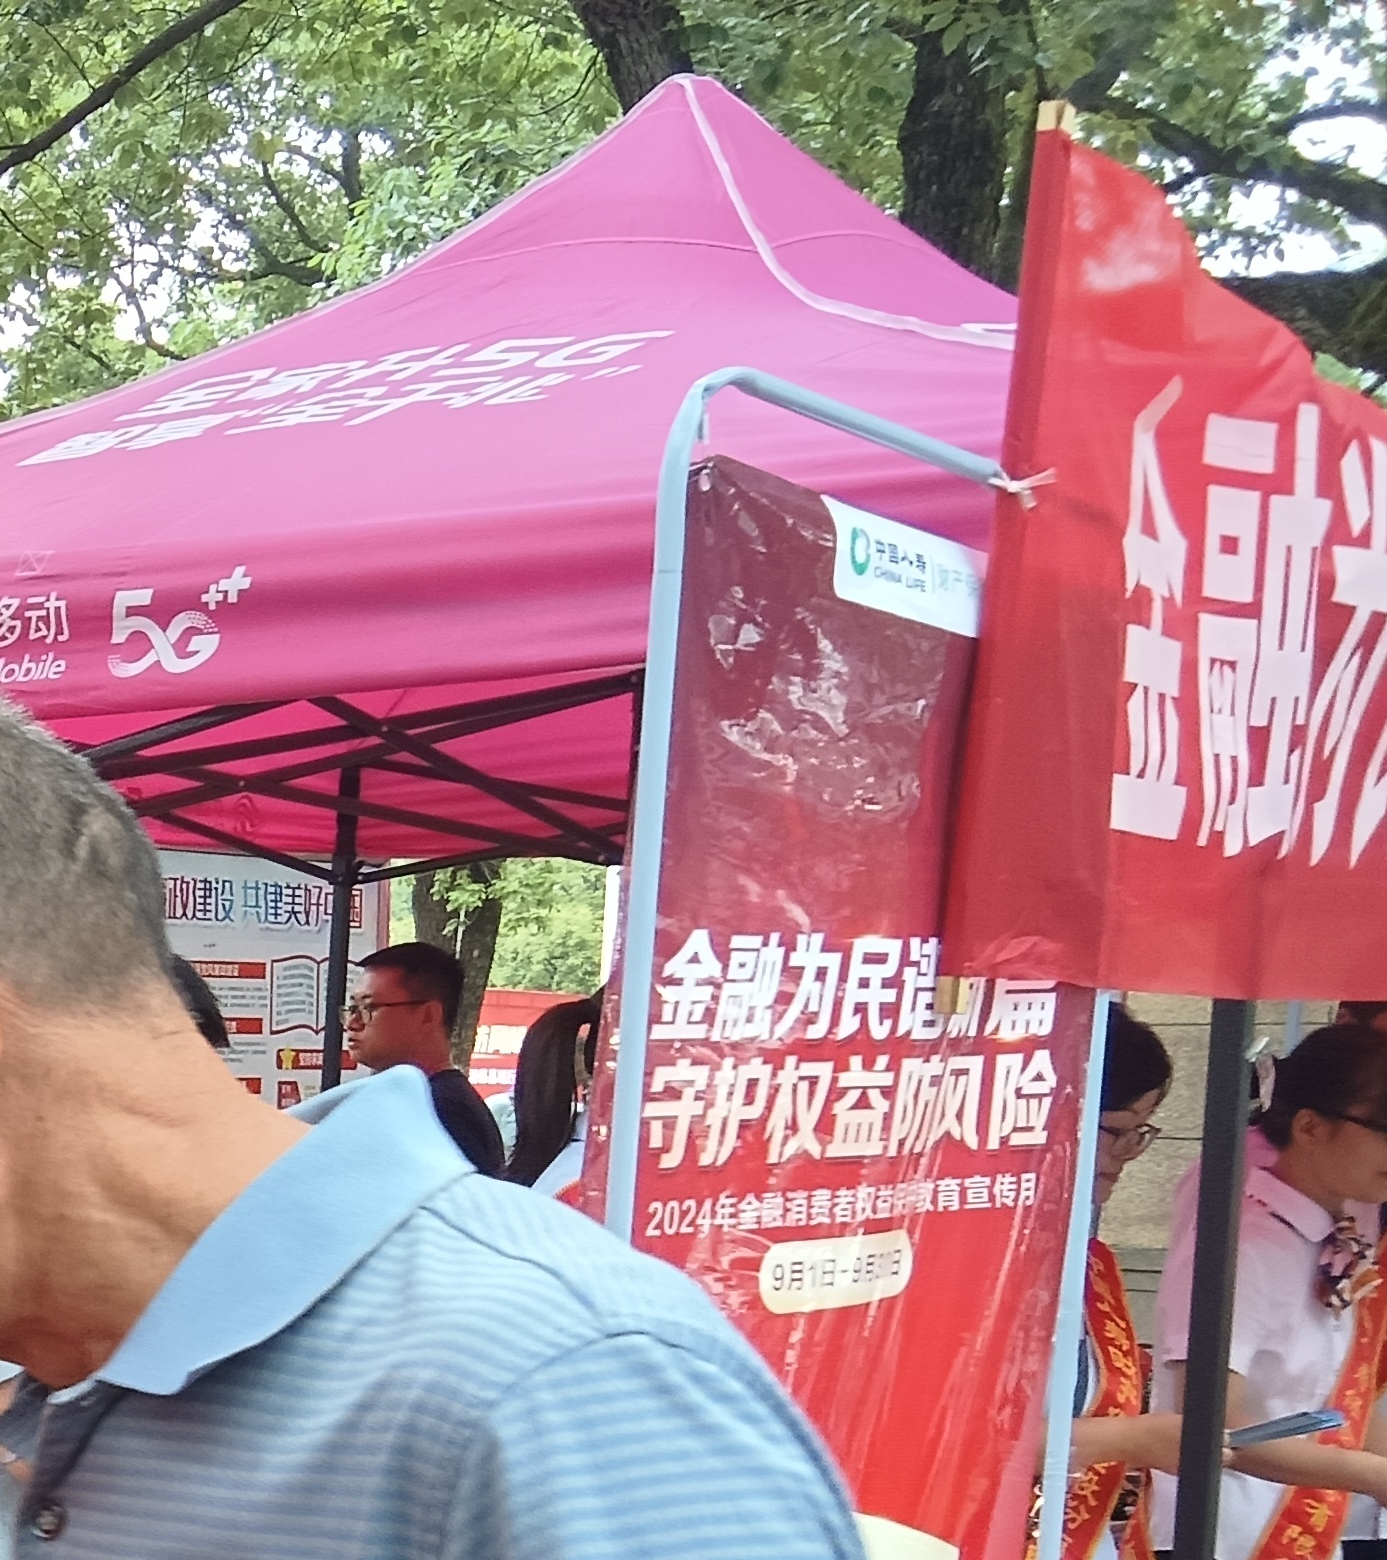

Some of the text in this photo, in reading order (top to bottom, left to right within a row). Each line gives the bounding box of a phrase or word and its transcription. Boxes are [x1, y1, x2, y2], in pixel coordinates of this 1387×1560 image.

[115, 329, 675, 421] 全家升5G
[160, 875, 234, 922] 政建设
[642, 1048, 1057, 1170] 守护权益防风险
